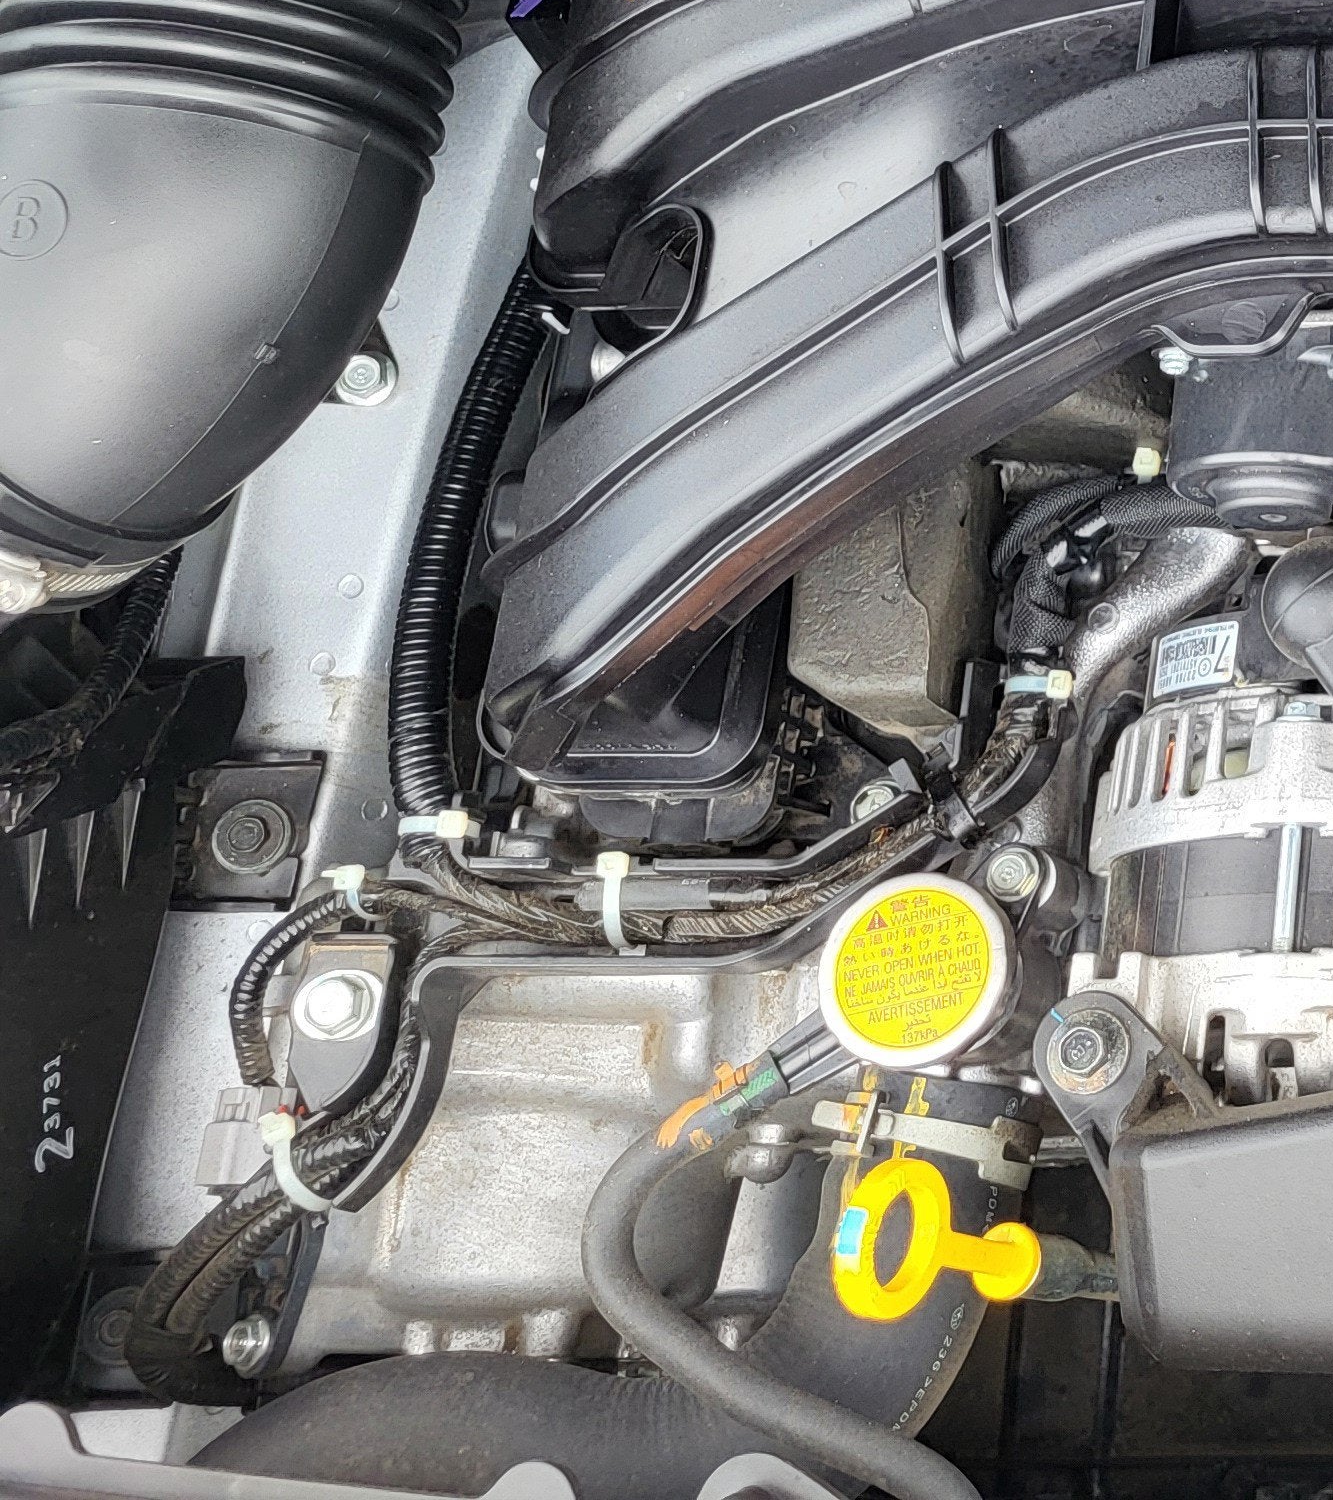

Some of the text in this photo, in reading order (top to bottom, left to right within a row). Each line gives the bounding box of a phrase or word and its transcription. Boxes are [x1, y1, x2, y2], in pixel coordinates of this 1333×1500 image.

[890, 904, 951, 926] WARNING
[844, 964, 880, 983] NEVER
[884, 957, 914, 975] OPEN
[918, 948, 953, 967] WHEN
[844, 986, 857, 999] NE
[861, 976, 896, 996] JAMAIS
[898, 967, 935, 986] OUVRIR
[947, 957, 981, 977] CHAUD
[868, 991, 964, 1025] AVERTISSEMENT
[902, 1031, 938, 1045] 137kPa
